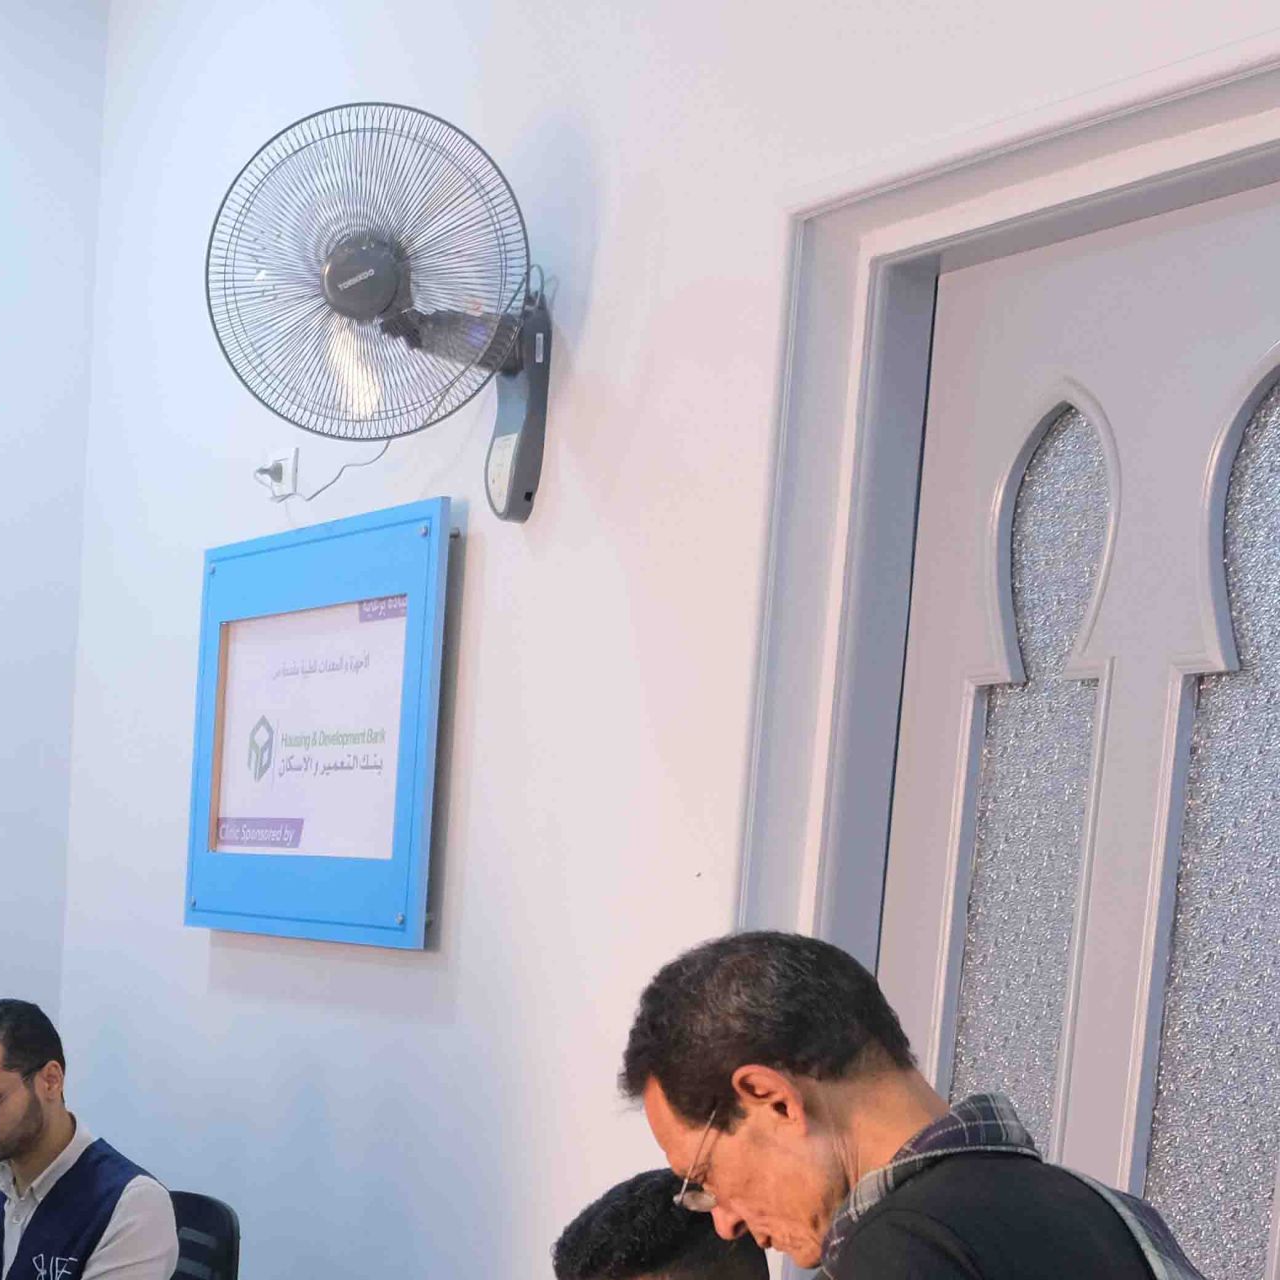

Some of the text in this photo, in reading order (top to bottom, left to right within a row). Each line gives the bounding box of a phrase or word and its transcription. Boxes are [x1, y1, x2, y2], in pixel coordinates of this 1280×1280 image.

[281, 732, 310, 750] Housing
[319, 728, 365, 748] Development
[367, 728, 385, 744] Bank
[320, 753, 359, 776] التعمير
[360, 753, 383, 775] بنك
[241, 824, 282, 844] Sponsored
[283, 824, 294, 846] by
